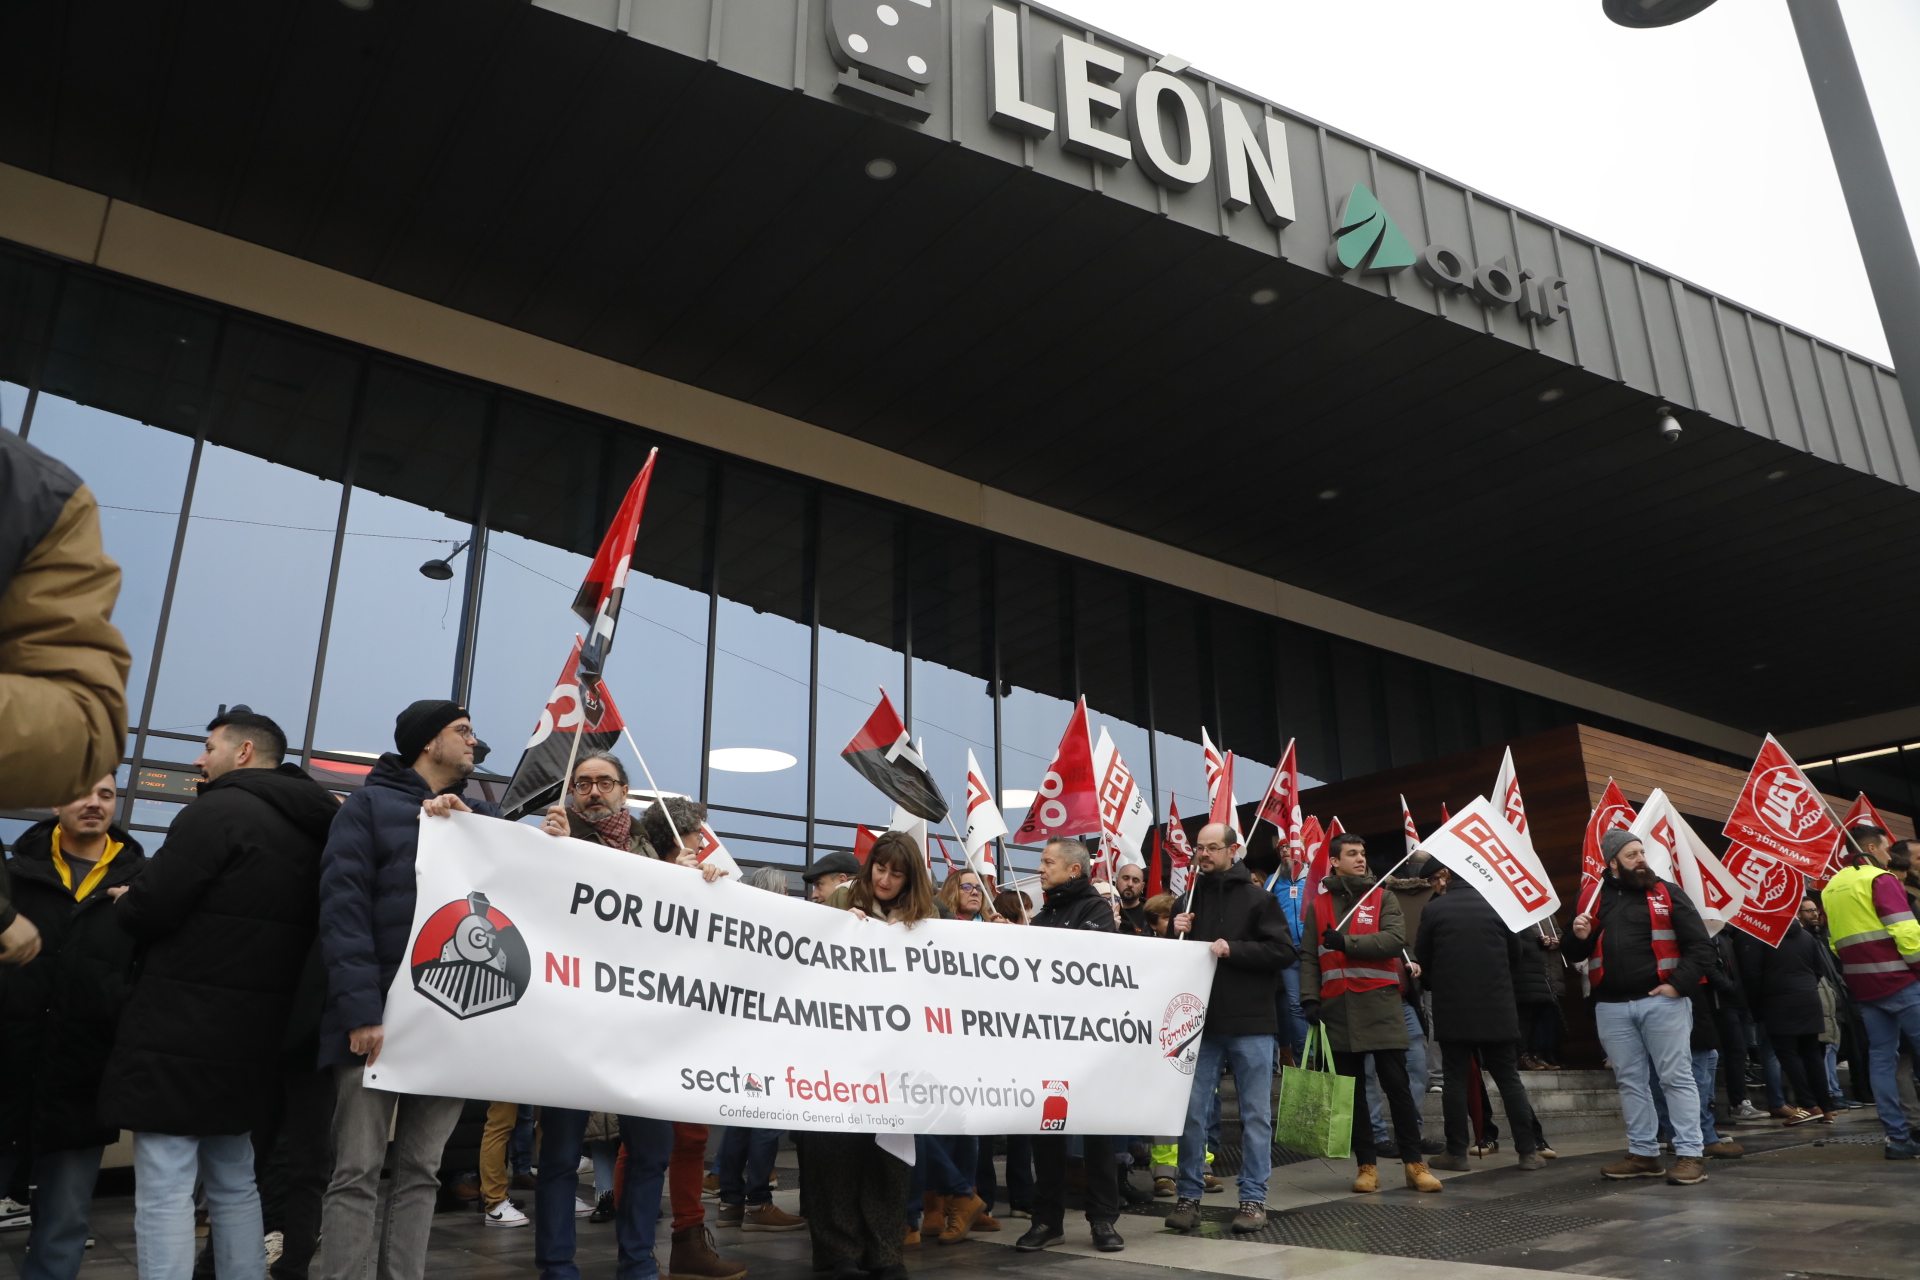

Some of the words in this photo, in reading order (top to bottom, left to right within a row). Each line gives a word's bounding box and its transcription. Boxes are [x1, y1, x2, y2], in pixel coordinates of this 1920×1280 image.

[987, 5, 1295, 228] LEÓN
[1416, 245, 1569, 326] adif
[1761, 771, 1807, 829] UGT
[1460, 820, 1543, 904] CCOO
[1464, 854, 1494, 882] León
[1741, 825, 1811, 865] www.ugt.es
[570, 882, 643, 928] POR
[653, 899, 699, 939] UN
[707, 913, 896, 973] FERROCARRIL
[905, 940, 1019, 982] PÚBLICO
[1024, 957, 1042, 983] Y
[1051, 960, 1139, 989] SOCIAL
[545, 952, 580, 988] NI
[595, 961, 911, 1032] DESMANTELAMIENTO
[925, 1007, 953, 1035] NI
[962, 1010, 1152, 1044] PRIVATIZACIÓN
[1159, 1005, 1207, 1050] Ferroviari
[785, 1066, 889, 1104] federal
[899, 1073, 1035, 1107] ferroviario
[719, 1105, 799, 1121] Confederación
[802, 1111, 844, 1123] General
[847, 1114, 863, 1125] del
[866, 1114, 905, 1127] Trabajo
[1042, 1119, 1064, 1129] CGT
